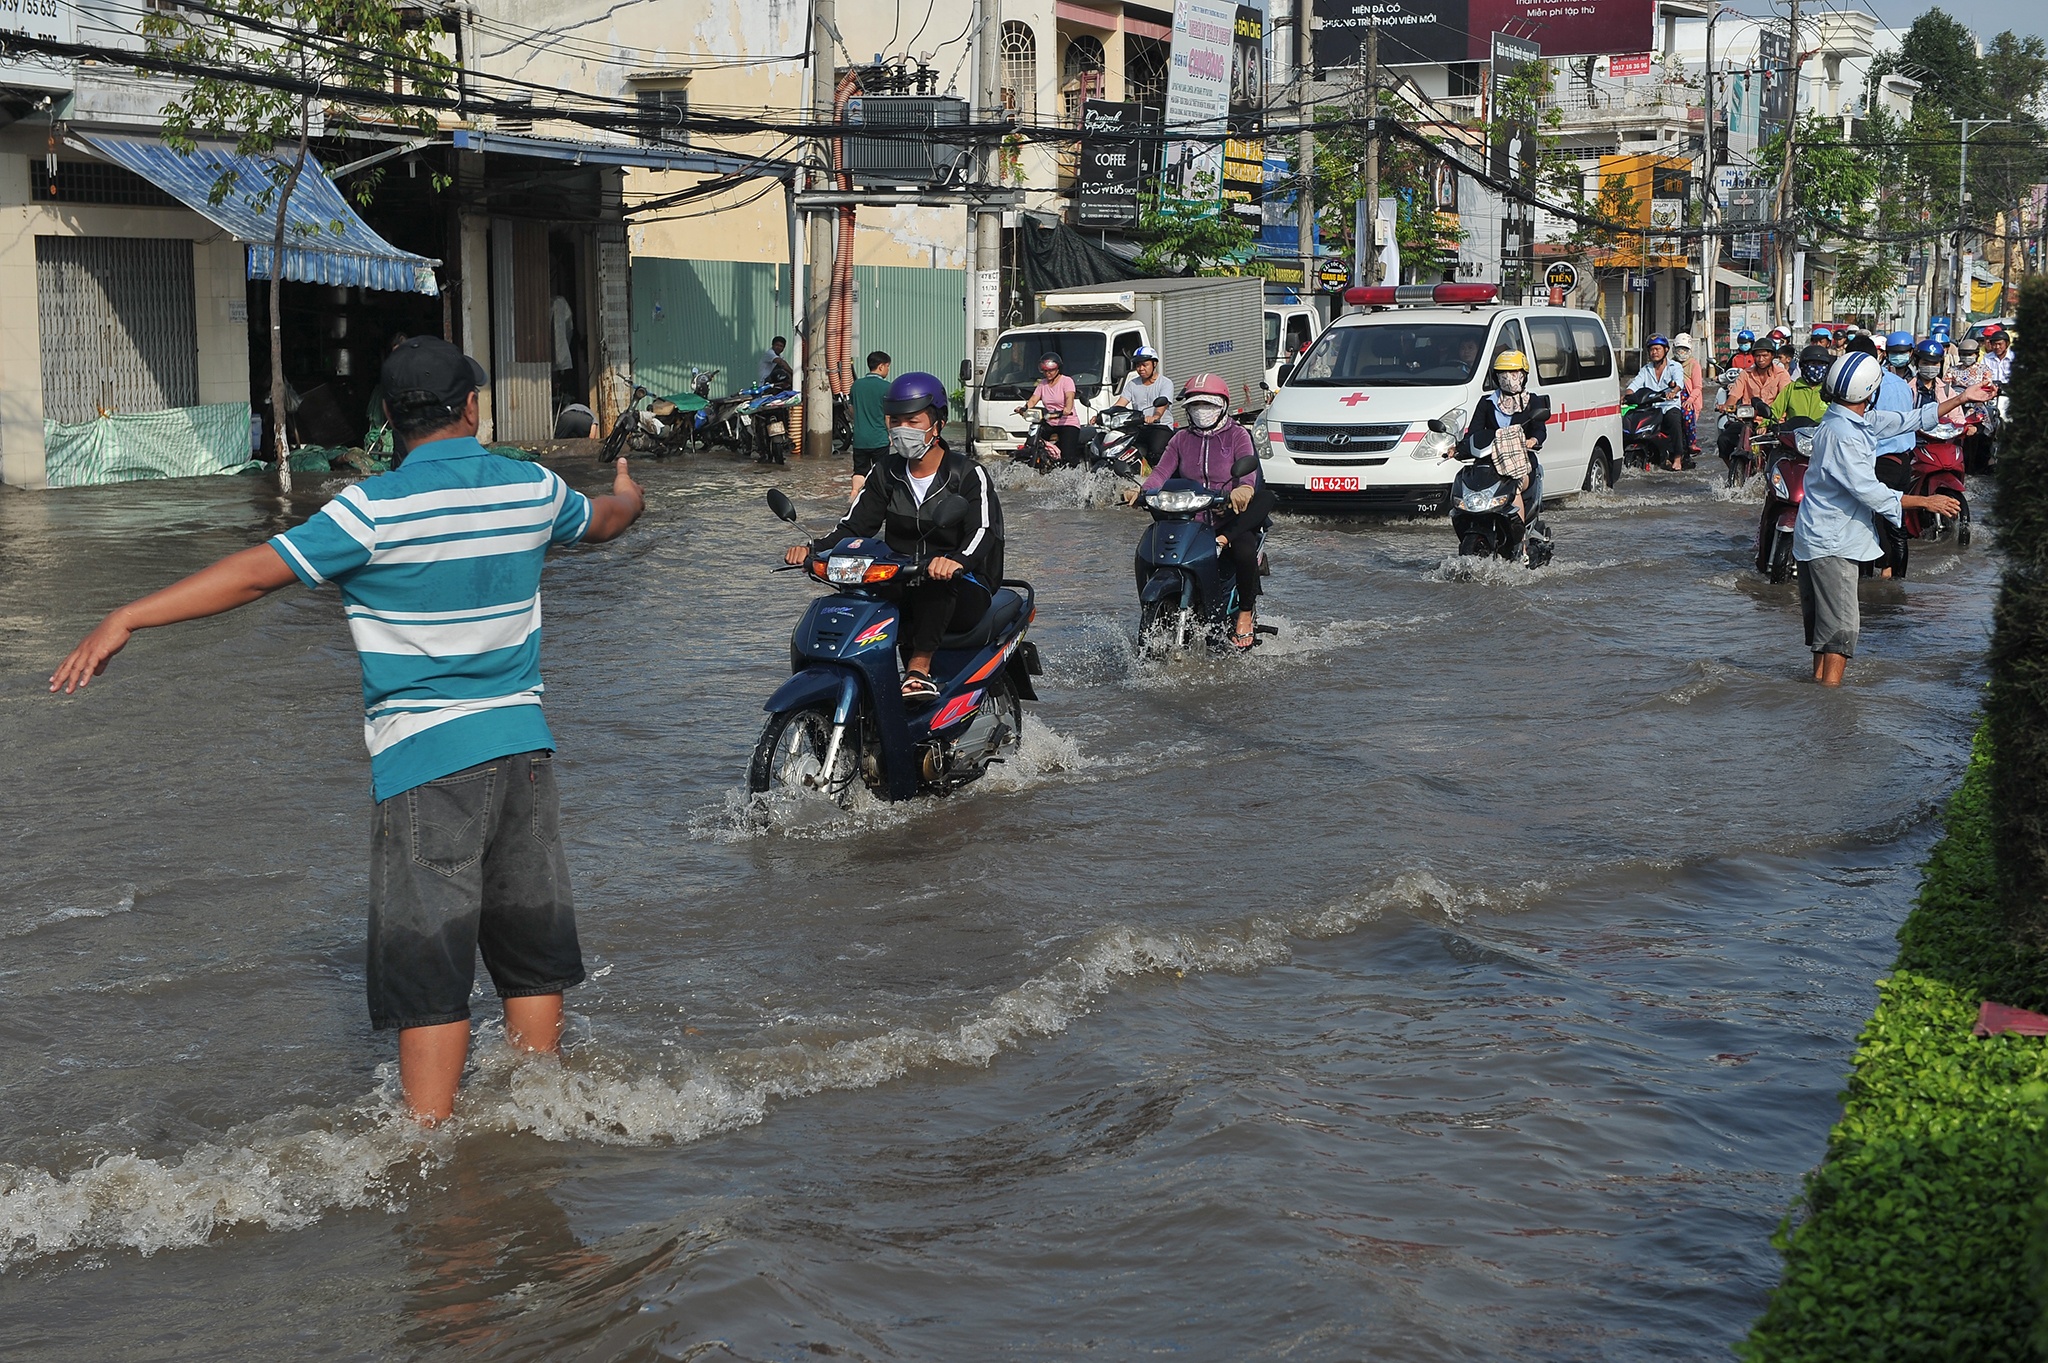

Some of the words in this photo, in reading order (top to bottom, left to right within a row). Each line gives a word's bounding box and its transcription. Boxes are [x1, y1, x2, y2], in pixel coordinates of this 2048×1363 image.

[1351, 5, 1371, 15] HIỆN
[1372, 3, 1385, 14] ĐÃ
[1386, 2, 1401, 13] CÓ
[1527, 7, 1547, 17] Miễn
[1549, 8, 1563, 17] phí
[1564, 7, 1579, 16] tập
[1581, 5, 1596, 14] thử
[1382, 16, 1397, 26] HỘI
[1399, 15, 1418, 25] VIÊN
[1419, 13, 1437, 23] MỚI
[1095, 153, 1126, 167] COFFEE
[1106, 169, 1114, 179] &
[1417, 503, 1438, 512] 70-17
